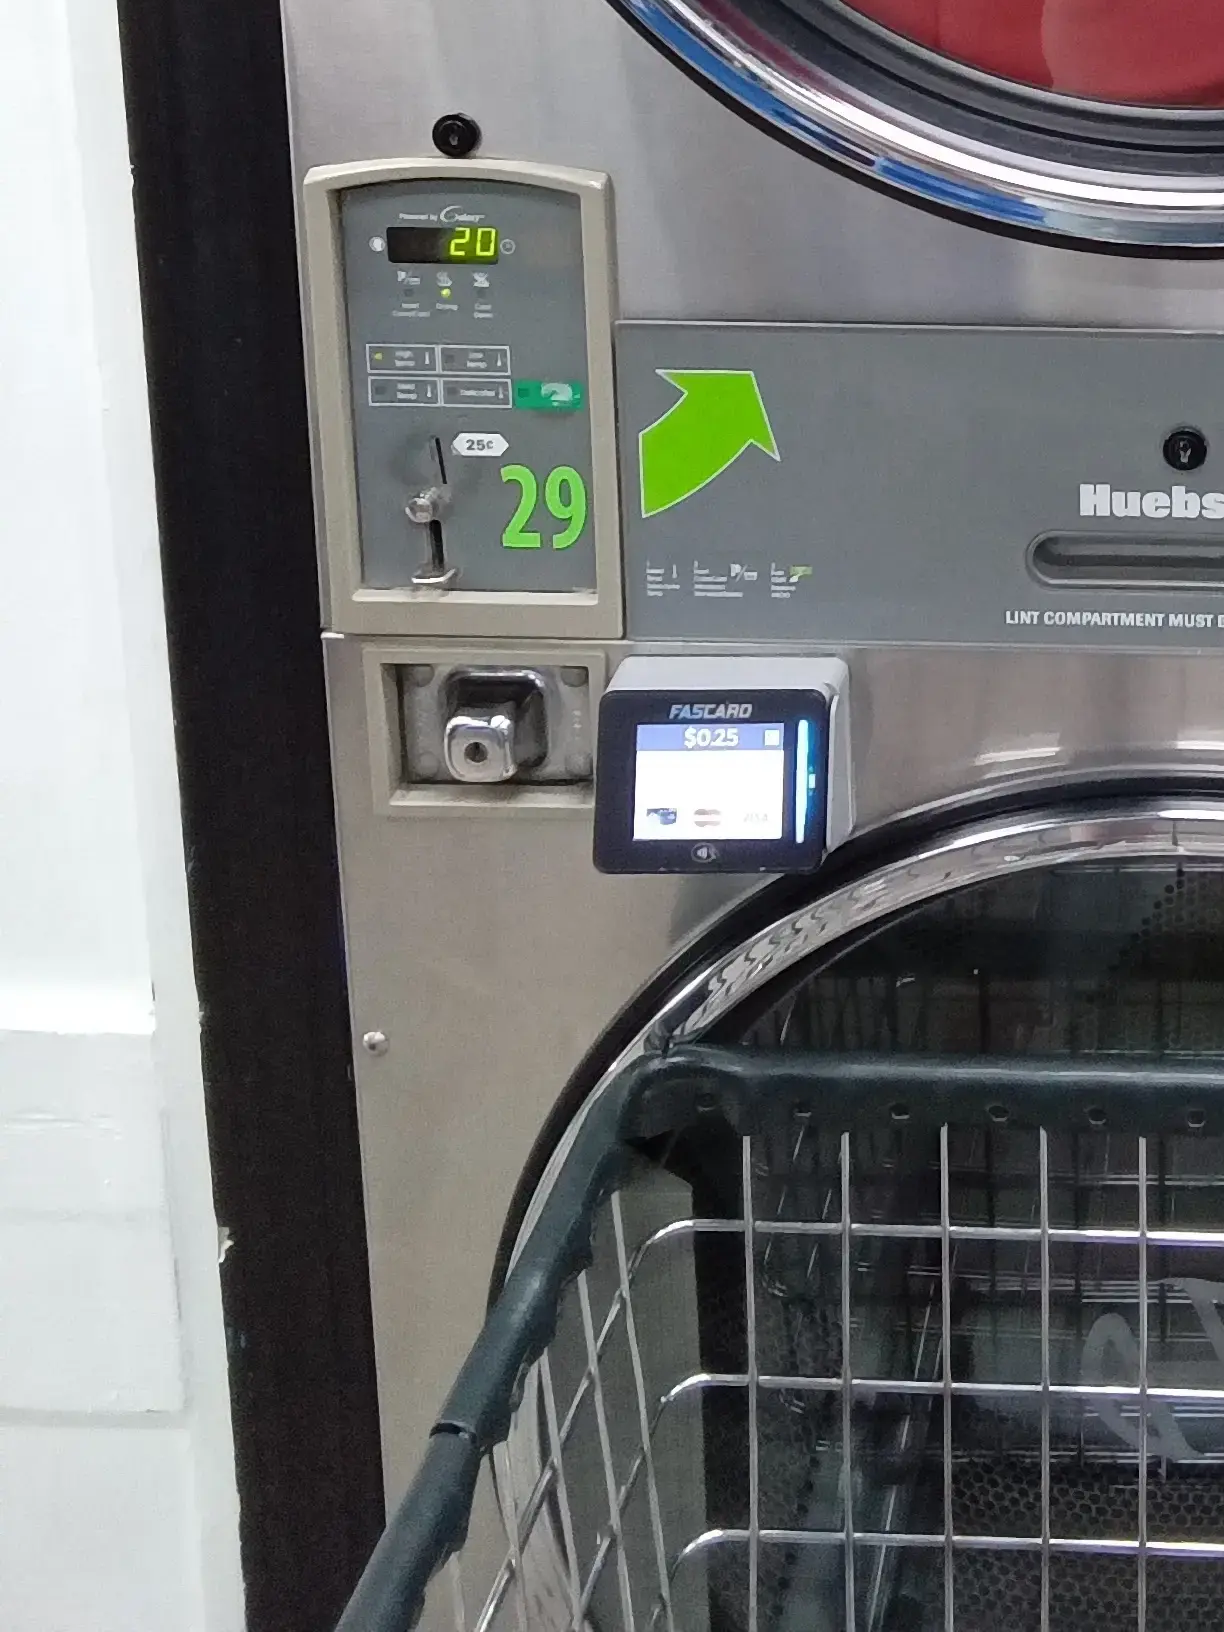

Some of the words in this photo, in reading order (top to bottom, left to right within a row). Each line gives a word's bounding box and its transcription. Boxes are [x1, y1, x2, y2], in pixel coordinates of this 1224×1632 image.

[450, 227, 496, 256] 20
[500, 464, 587, 549] 29
[1005, 610, 1040, 625] LINT
[1043, 611, 1165, 627] COMPARTMENT
[1168, 613, 1214, 628] MUST
[669, 703, 753, 719] FASCARD
